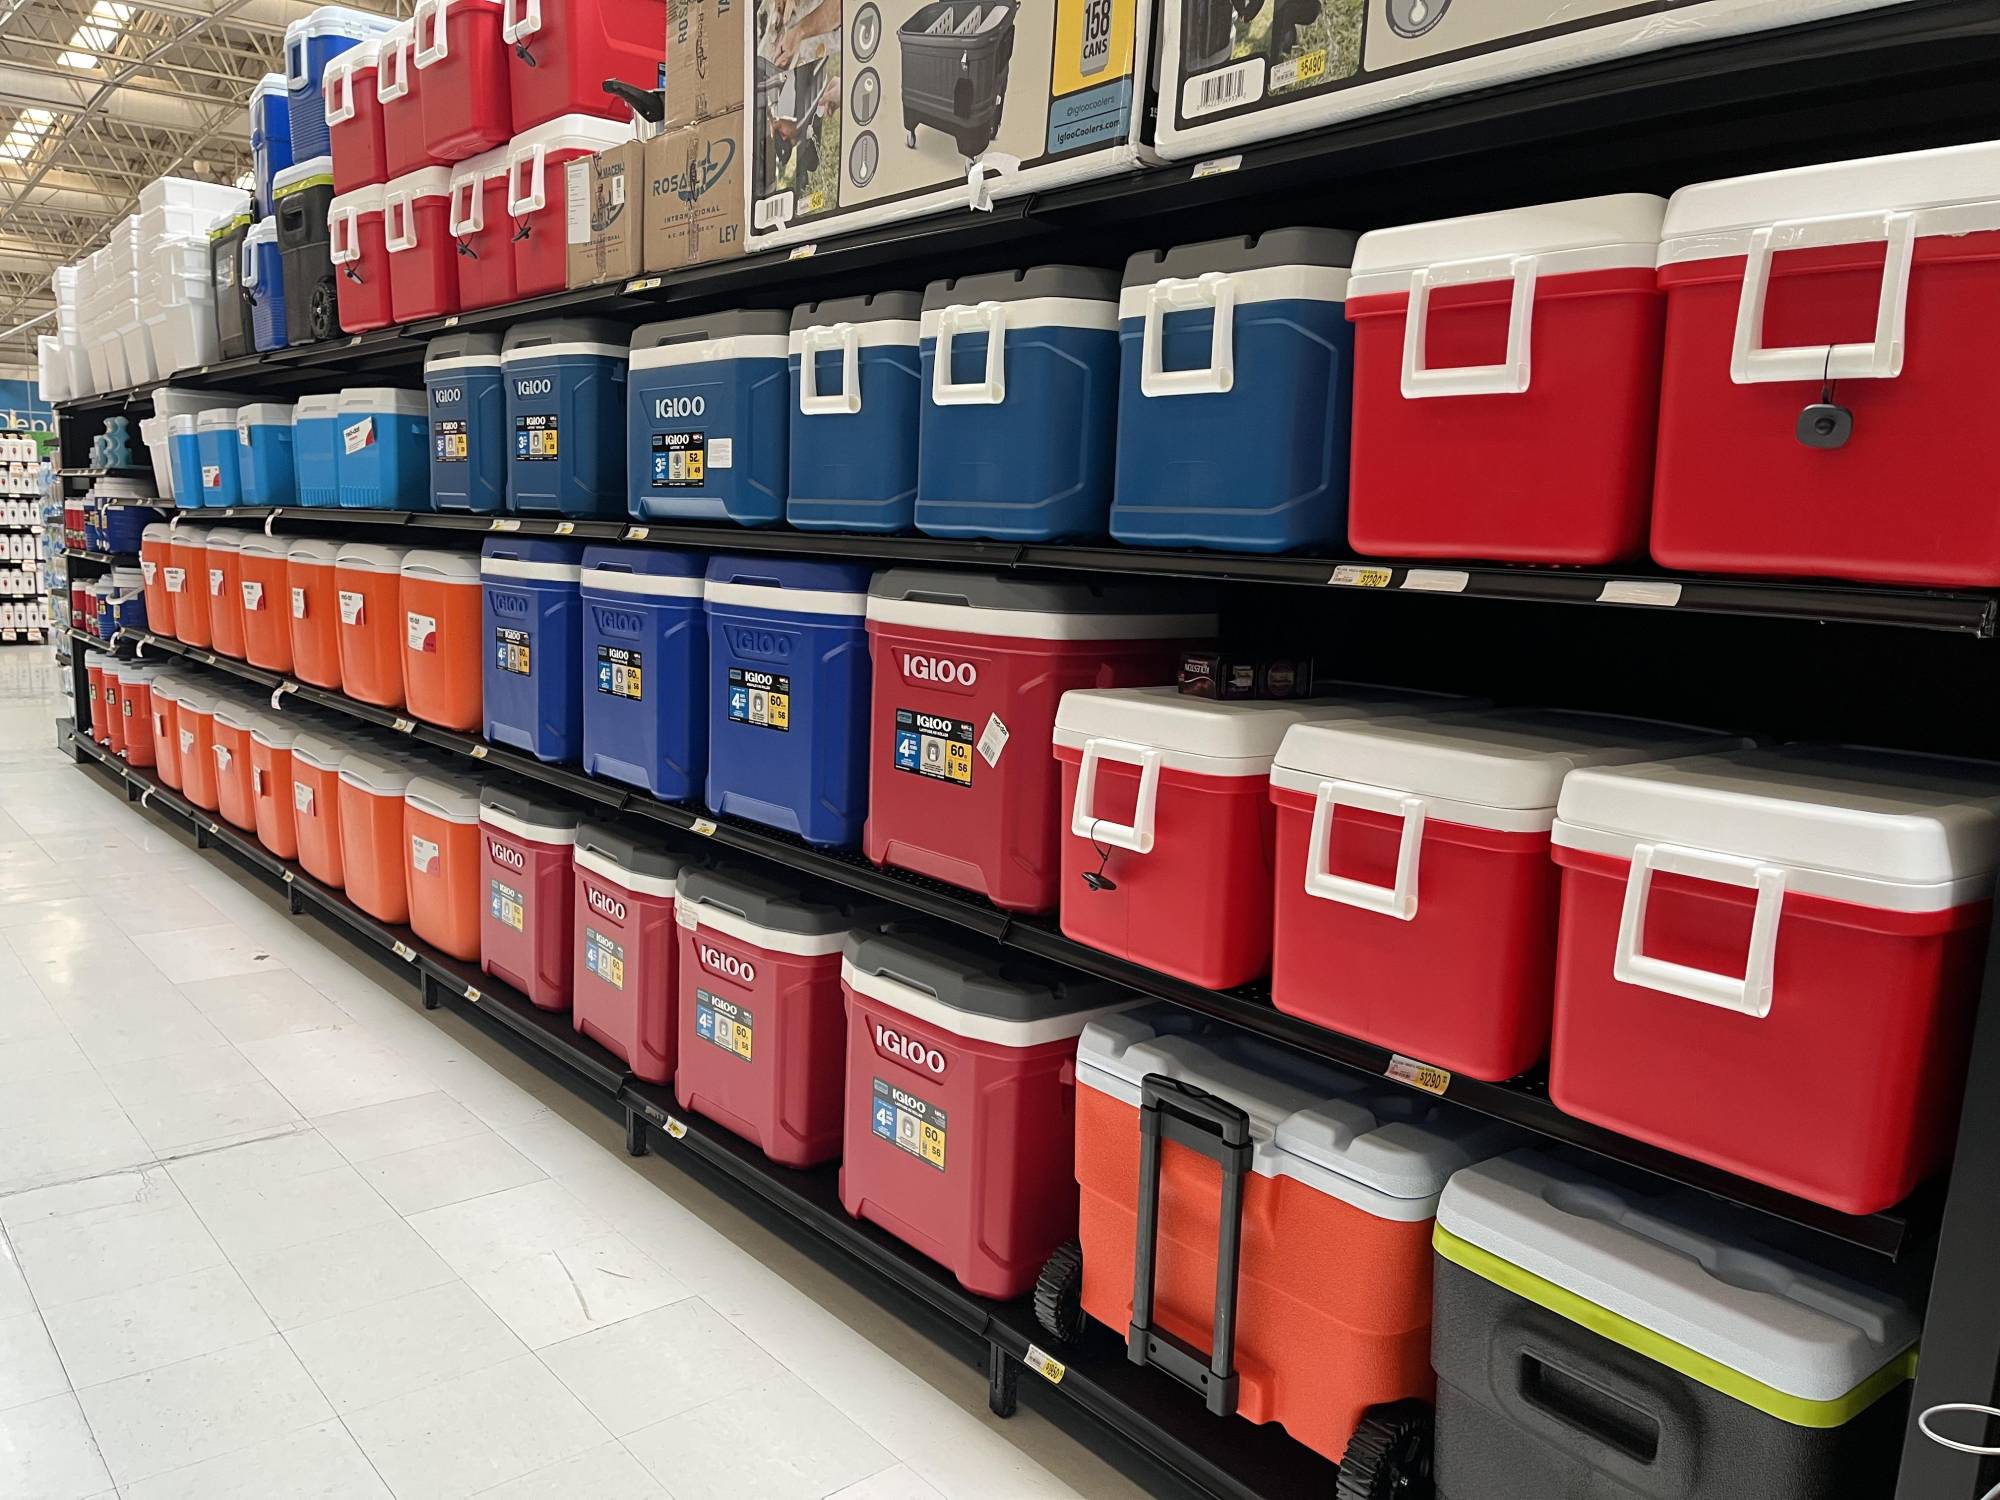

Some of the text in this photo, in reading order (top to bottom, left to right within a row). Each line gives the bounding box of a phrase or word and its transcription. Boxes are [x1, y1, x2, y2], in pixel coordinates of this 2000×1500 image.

[1085, 0, 1112, 42] 158
[1083, 38, 1108, 59] CANS
[1066, 95, 1115, 117] @igloocoolers
[1057, 119, 1120, 145] IglooCoolers.com
[664, 204, 720, 224] INTERNCIONAL
[719, 224, 738, 244] LEY
[435, 388, 461, 403] IGLOO
[518, 379, 551, 396] IGLOO
[655, 396, 705, 418] IGLOO
[443, 422, 458, 430] IGLOO
[526, 416, 546, 426] IGLOO
[665, 434, 690, 445] IGLOO
[495, 594, 528, 612] IGLOO
[600, 610, 642, 632] IGLOO
[505, 630, 520, 641] IGLOO
[735, 629, 793, 657] IGLOO
[609, 648, 629, 660] IGLOO
[745, 671, 773, 686] IGLOO
[903, 653, 977, 686] IGLOO
[916, 714, 952, 732] IGLOO
[899, 738, 910, 758] 4
[950, 744, 965, 758] 60
[957, 762, 968, 773] 56
[491, 842, 524, 868] IGLOO
[588, 887, 626, 920] IGLOO
[596, 933, 614, 950] IGLOO
[701, 944, 755, 982] IGLOO
[711, 995, 738, 1015] IGLOO
[875, 1024, 946, 1074] IGLOO
[892, 1087, 926, 1114] IGLOO
[876, 1107, 887, 1126] 4
[925, 1126, 938, 1142] 60
[931, 1145, 941, 1158] 56
